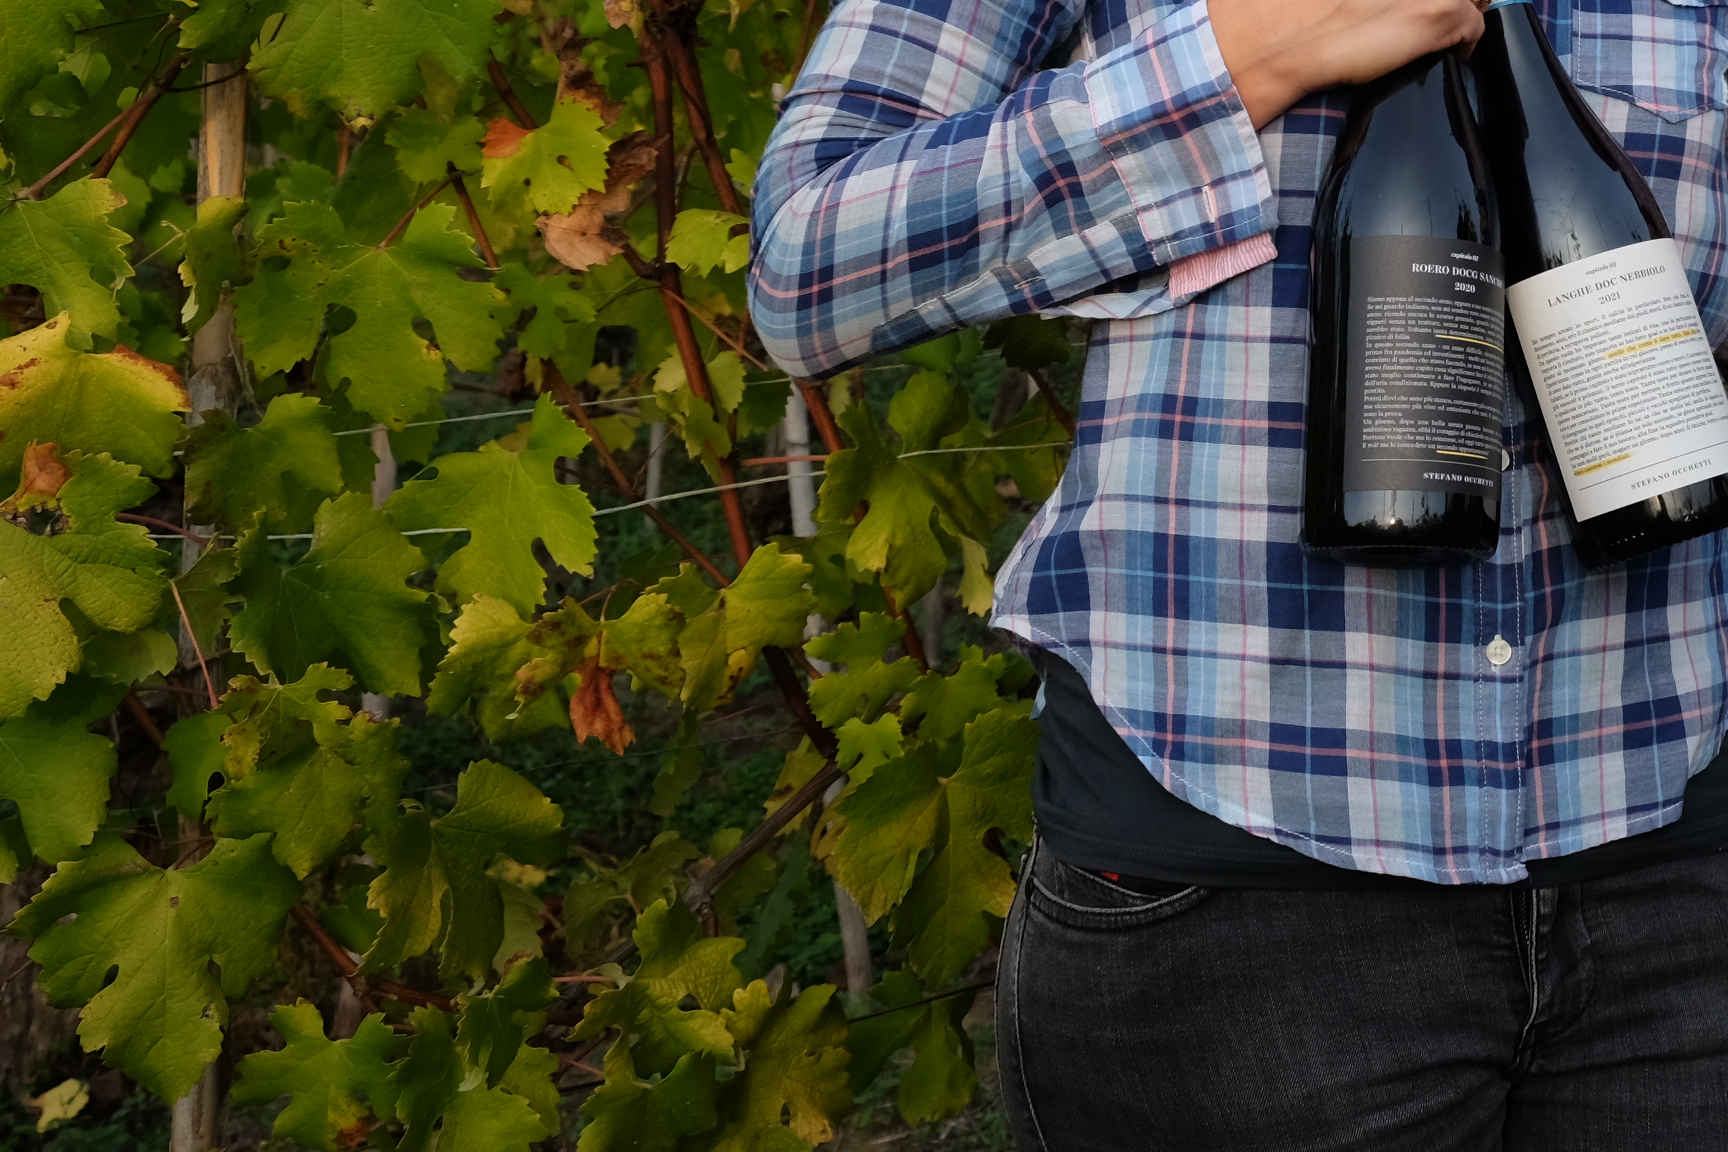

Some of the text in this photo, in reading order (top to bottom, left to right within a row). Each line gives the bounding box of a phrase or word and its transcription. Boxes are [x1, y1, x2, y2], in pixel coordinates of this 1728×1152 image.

[1412, 263, 1450, 275] ROERO
[1452, 266, 1478, 279] DOCG
[1585, 264, 1609, 276] capitolo
[1454, 281, 1476, 293] 2020
[1547, 265, 1666, 307] LANGHE DOC NEBBIOLO
[1598, 291, 1621, 305] 2021
[1423, 472, 1494, 488] STEFANO OCCHETTI
[1630, 458, 1712, 490] STEFANO OCCHETTI
